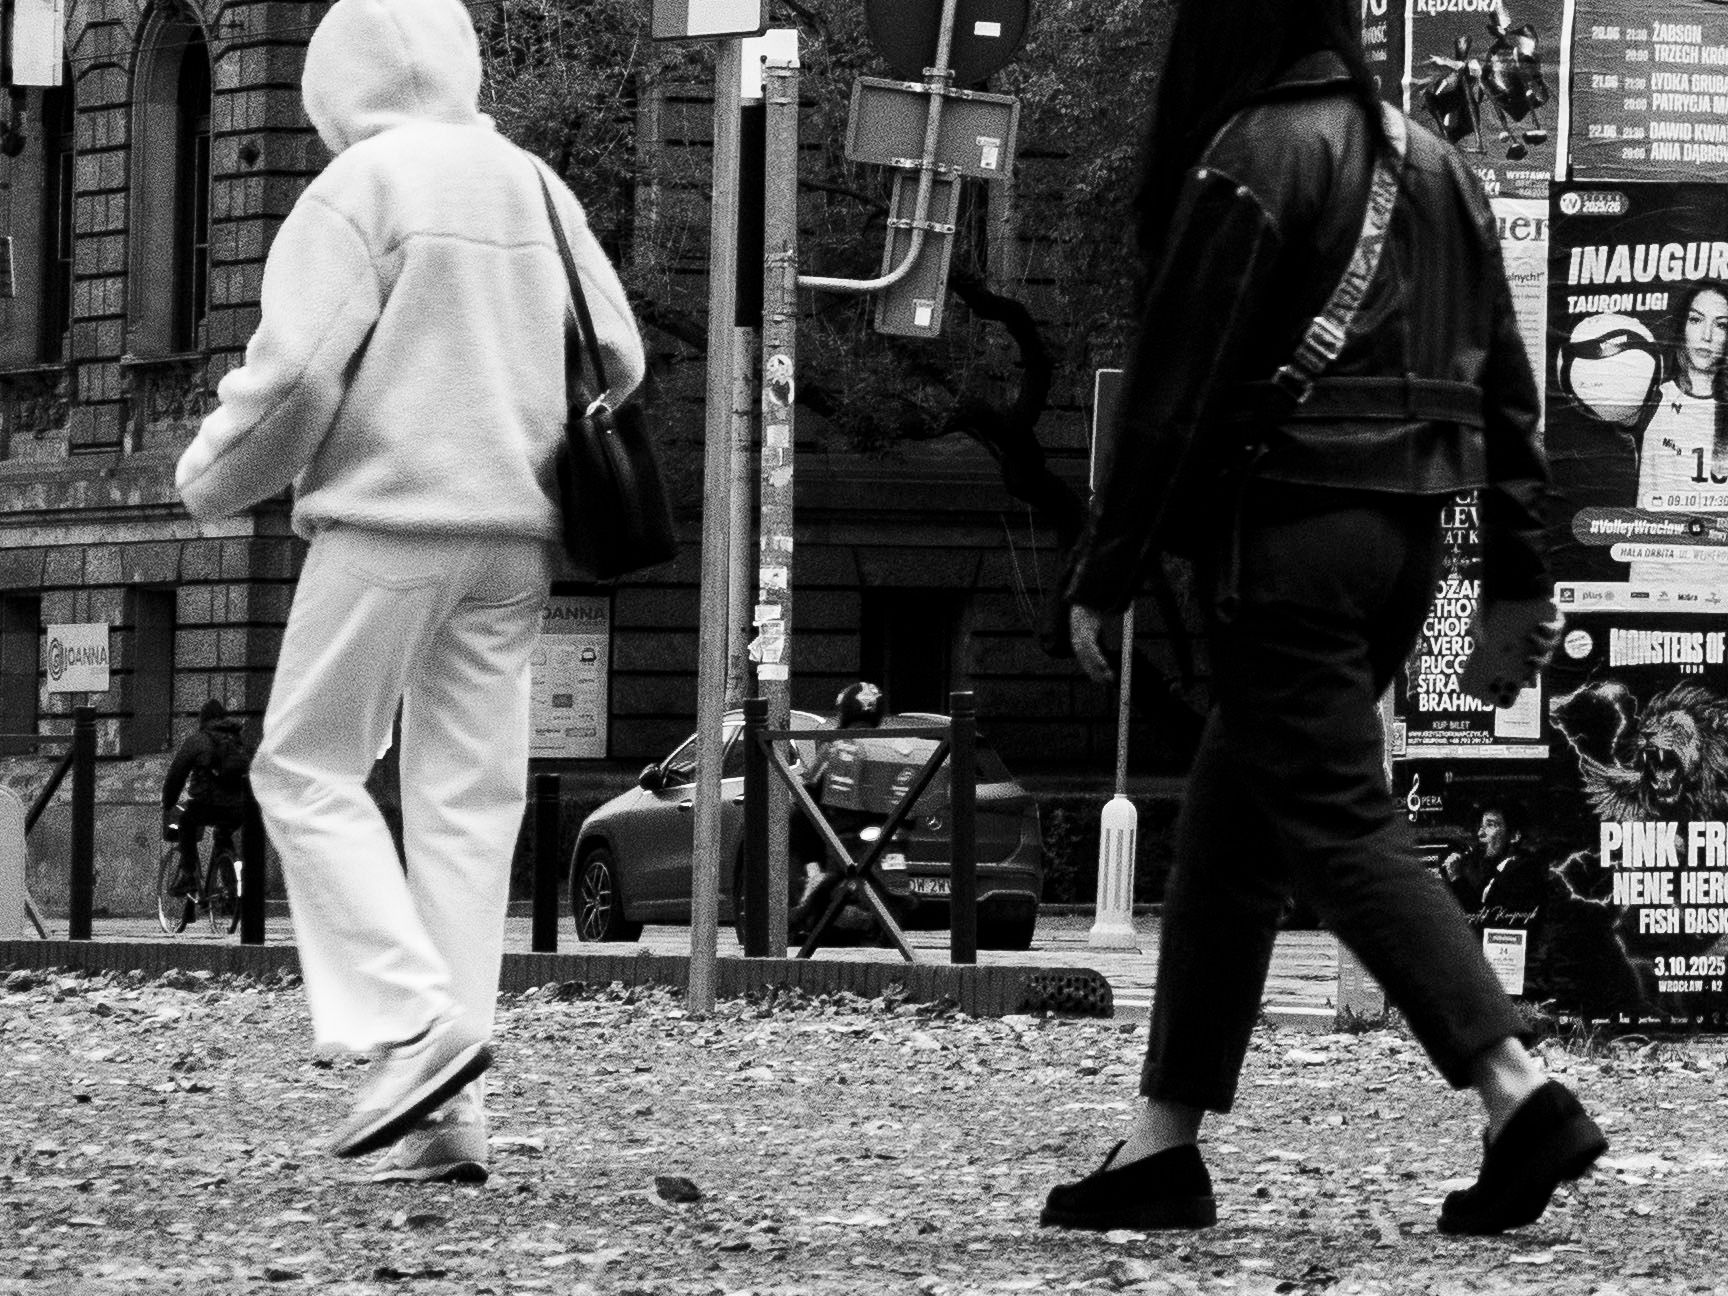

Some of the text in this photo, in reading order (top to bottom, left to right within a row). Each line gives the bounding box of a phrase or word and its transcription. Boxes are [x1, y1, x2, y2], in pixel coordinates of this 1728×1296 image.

[1652, 21, 1702, 44] ŻABSON
[1655, 44, 1699, 64] TRZECH
[1592, 74, 1619, 89] 21.06
[1651, 73, 1690, 92] ŁYDKA
[1652, 93, 1711, 113] PATRYCJA
[1589, 124, 1617, 138] 22.06
[1650, 121, 1693, 141] DAWID
[1650, 141, 1682, 162] ANIA
[1506, 170, 1550, 180] WYSTAWA
[1567, 293, 1669, 314] TAURON LIGI
[1667, 494, 1697, 507] 09.10
[1620, 548, 1643, 558] HALA
[1644, 548, 1675, 559] ORBITA
[1610, 628, 1704, 668] MONSTERS
[1706, 631, 1727, 664] OF
[1600, 820, 1680, 868] PINK
[1613, 870, 1675, 905] NENE
[1639, 908, 1680, 934] FISH
[1654, 956, 1727, 977] 3.10.2025
[1658, 979, 1705, 993] WROCŁAW
